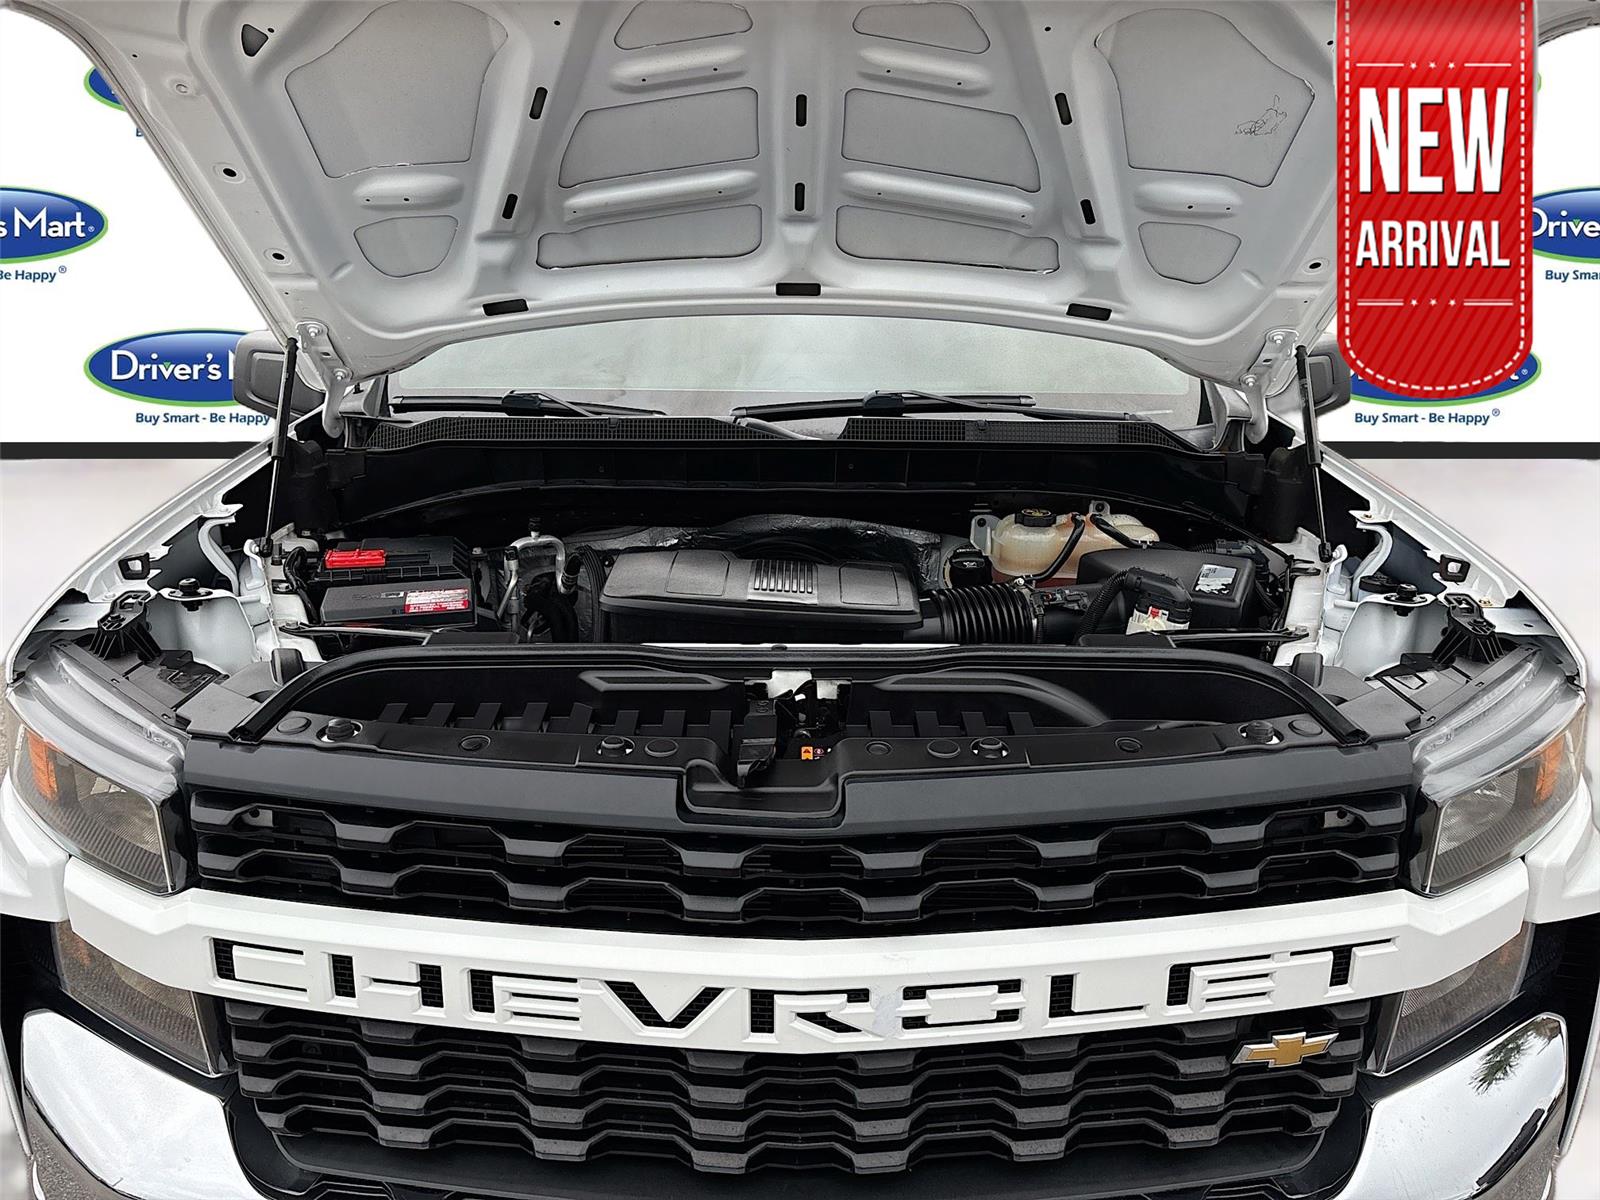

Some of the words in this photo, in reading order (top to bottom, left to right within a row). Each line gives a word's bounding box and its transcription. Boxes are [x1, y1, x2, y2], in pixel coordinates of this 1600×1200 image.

[14, 207, 86, 237] Mart
[1545, 269, 1569, 283] Buy
[1572, 269, 1600, 281] Sma
[111, 350, 222, 381] Driver's
[135, 412, 160, 426] Buy
[163, 412, 199, 424] Smart
[209, 412, 226, 424] Be
[229, 412, 270, 426] Happy
[1354, 412, 1379, 426] Buy
[1382, 412, 1418, 424] Smart
[1428, 412, 1445, 424] Be
[208, 936, 1396, 1040] CHEVROLET
